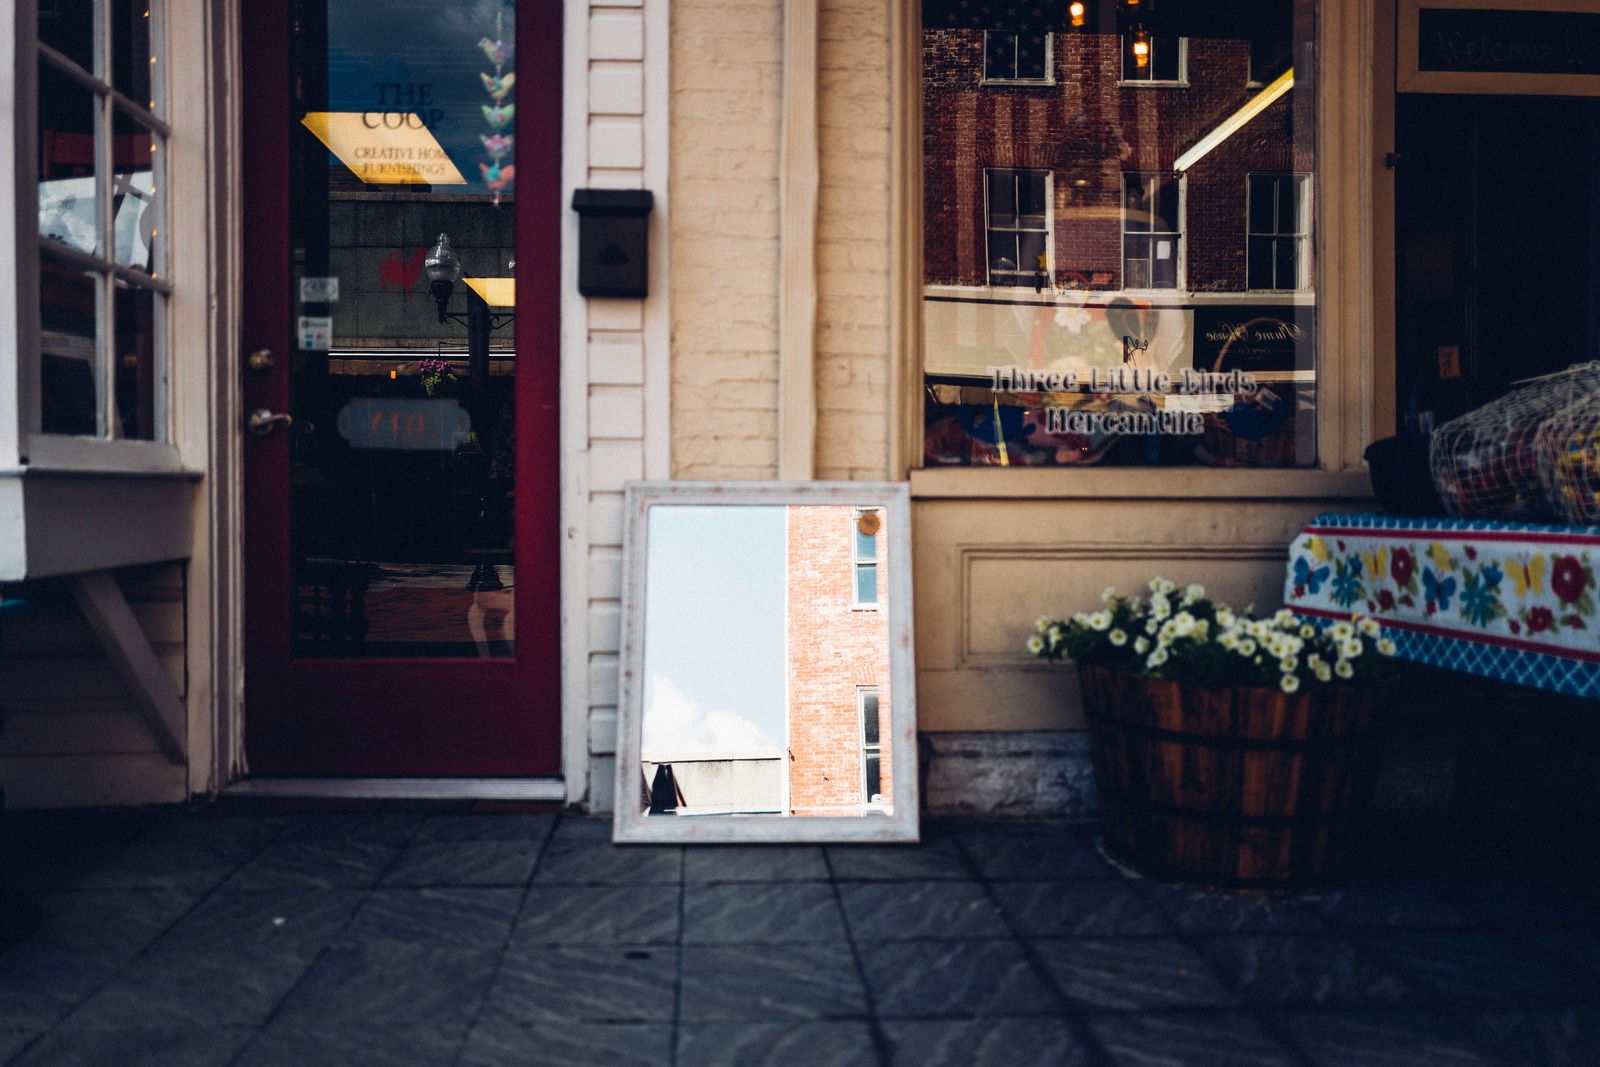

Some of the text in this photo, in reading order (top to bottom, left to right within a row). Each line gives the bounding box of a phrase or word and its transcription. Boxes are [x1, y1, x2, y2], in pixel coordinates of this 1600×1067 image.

[373, 83, 432, 106] THE
[362, 108, 444, 130] COOP
[354, 147, 414, 160] CREATIVE
[363, 163, 446, 176] FURNISHINGS
[990, 365, 1259, 395] Three Little Birds
[1044, 406, 1206, 435] Mercantile
